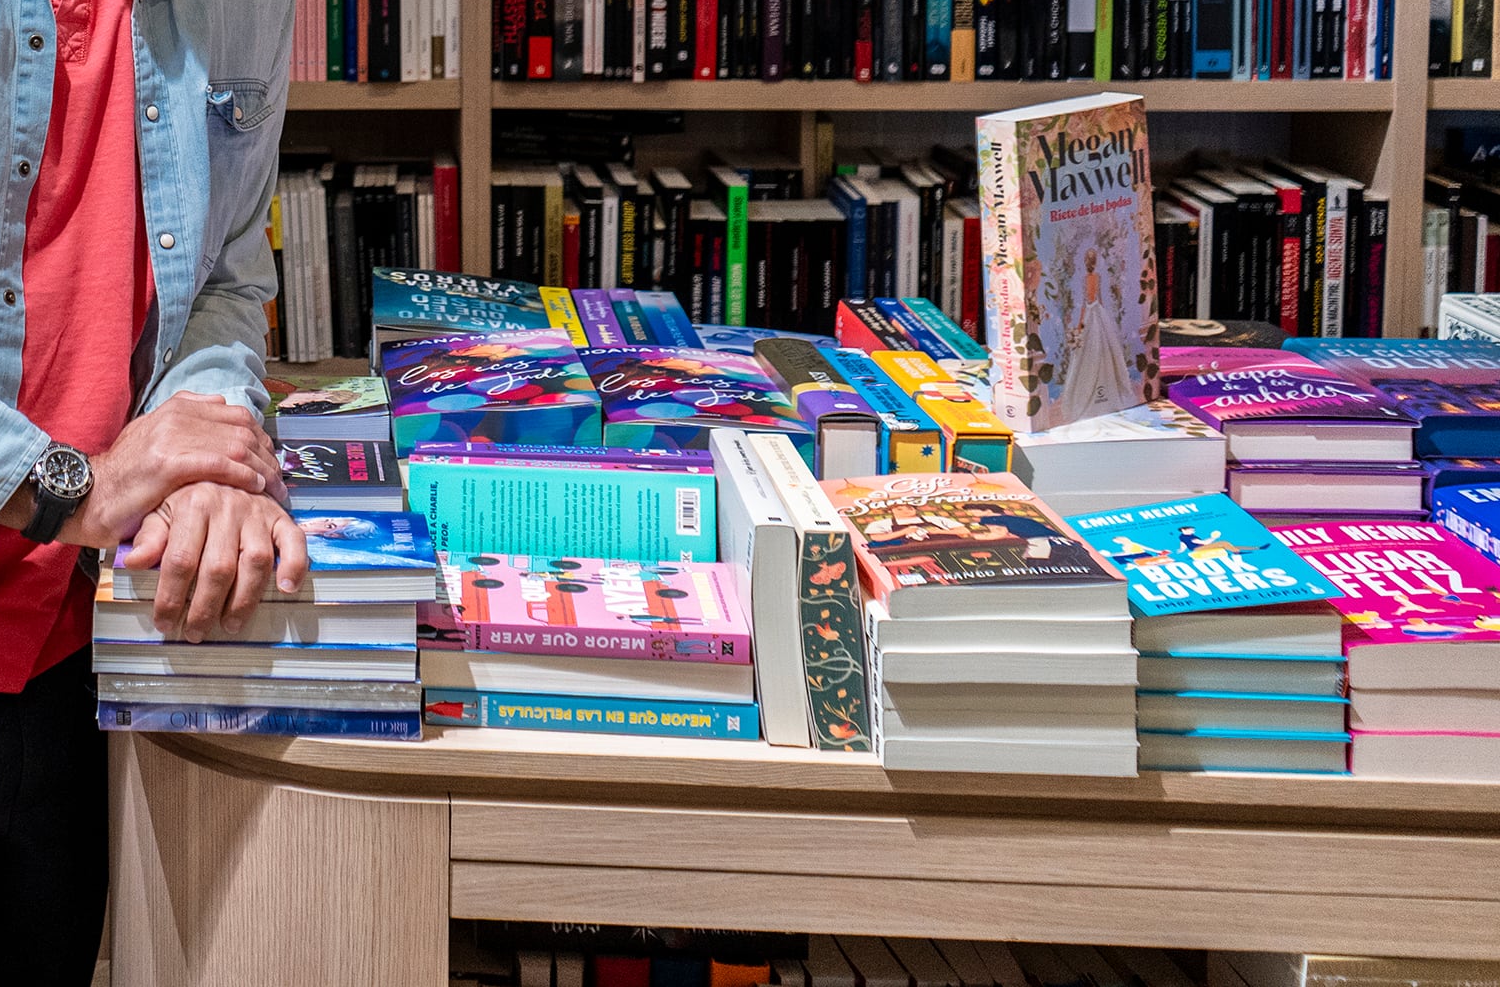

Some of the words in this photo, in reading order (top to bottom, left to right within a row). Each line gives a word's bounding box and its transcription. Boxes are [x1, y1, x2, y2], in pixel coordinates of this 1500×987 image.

[1037, 125, 1135, 170] Megan
[989, 140, 1004, 212] Maxwell
[1028, 148, 1146, 204] Maxwell
[1075, 204, 1088, 218] de
[1089, 202, 1104, 217] las
[1104, 196, 1133, 215] bodas
[996, 212, 1009, 268] Megan
[388, 271, 523, 295] YARROS
[1002, 278, 1013, 317] bodas
[391, 336, 463, 349] JOANA
[470, 328, 558, 342] MARCUS
[1003, 321, 1013, 339] las
[578, 346, 653, 357] JOANA
[663, 346, 728, 362] MARCUS
[1003, 340, 1014, 358] de
[1328, 348, 1354, 357] EL
[1366, 347, 1452, 359] CLUB
[883, 476, 955, 495] Café
[431, 480, 440, 520] CHARLIE,
[902, 488, 1036, 507] Francisco
[1077, 511, 1135, 530] EMILY
[1141, 502, 1200, 523] HENRY
[441, 521, 450, 549] PEOR.
[1138, 555, 1258, 583] BOOK
[1306, 550, 1452, 573] LUGAR
[519, 576, 552, 602] QUE
[1131, 567, 1299, 602] LOVERS
[1324, 571, 1483, 598] FELIZ
[489, 631, 536, 647] AYER
[541, 632, 578, 648] QUE
[588, 635, 646, 651] MEJOR
[498, 706, 572, 724] PELÍCULAS
[575, 709, 602, 722] LAS
[604, 710, 624, 723] EN
[628, 710, 659, 726] QUE
[660, 711, 712, 728] MEJOR
